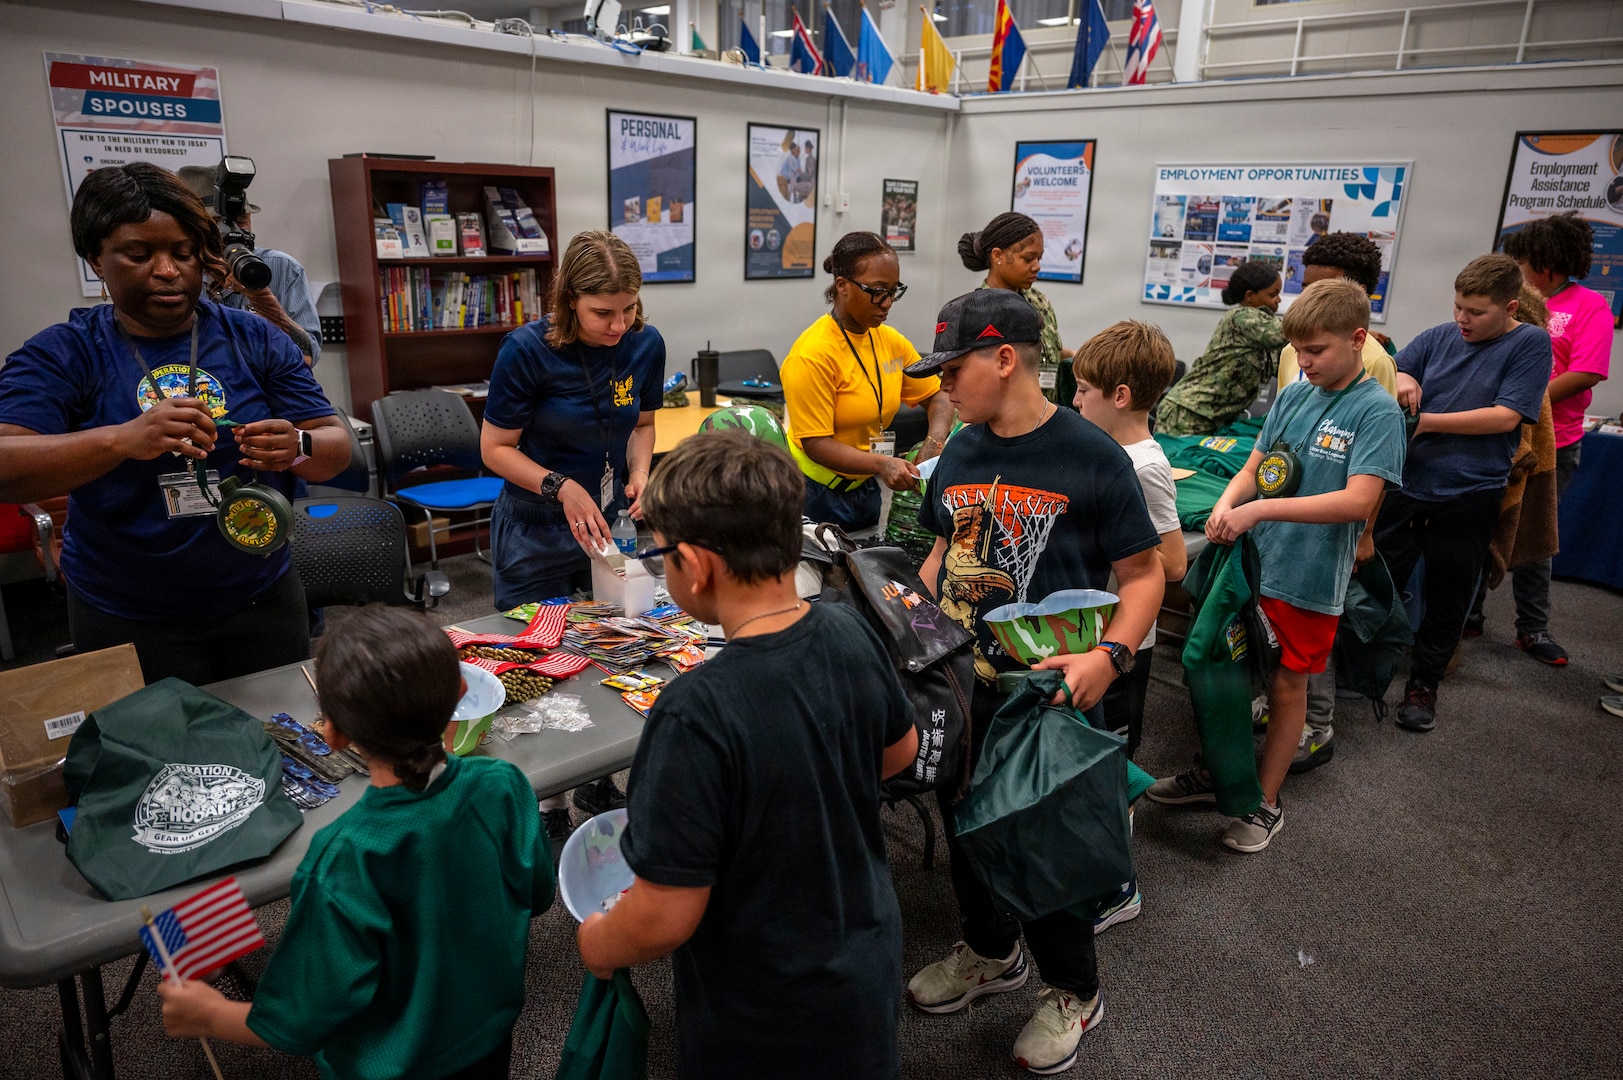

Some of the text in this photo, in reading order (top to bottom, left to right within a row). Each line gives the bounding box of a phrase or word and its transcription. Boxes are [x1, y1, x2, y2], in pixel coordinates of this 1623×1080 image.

[89, 70, 180, 92] MILITARY
[90, 97, 187, 118] SPOUSES
[621, 118, 682, 140] PERSONAL
[80, 134, 94, 142] NEW
[97, 135, 106, 143] TO
[123, 136, 160, 146] MILITARY?
[161, 138, 175, 146] NEW
[178, 139, 186, 147] TO
[145, 147, 188, 156] RESOURCES?
[1027, 165, 1085, 176] VOLUNTEERS
[1160, 168, 1360, 181] EMPLOYMENT OPPORTUNITIES
[1530, 161, 1599, 178] Employment
[1032, 177, 1079, 187] WELCOME
[1531, 178, 1590, 192] Assistance
[1509, 194, 1607, 210] Program Schedule
[1318, 419, 1355, 445] Charming
[169, 800, 237, 823] HOOAH!
[154, 833, 179, 842] GEAR
[198, 827, 215, 837] GET
[217, 811, 246, 829] READY
